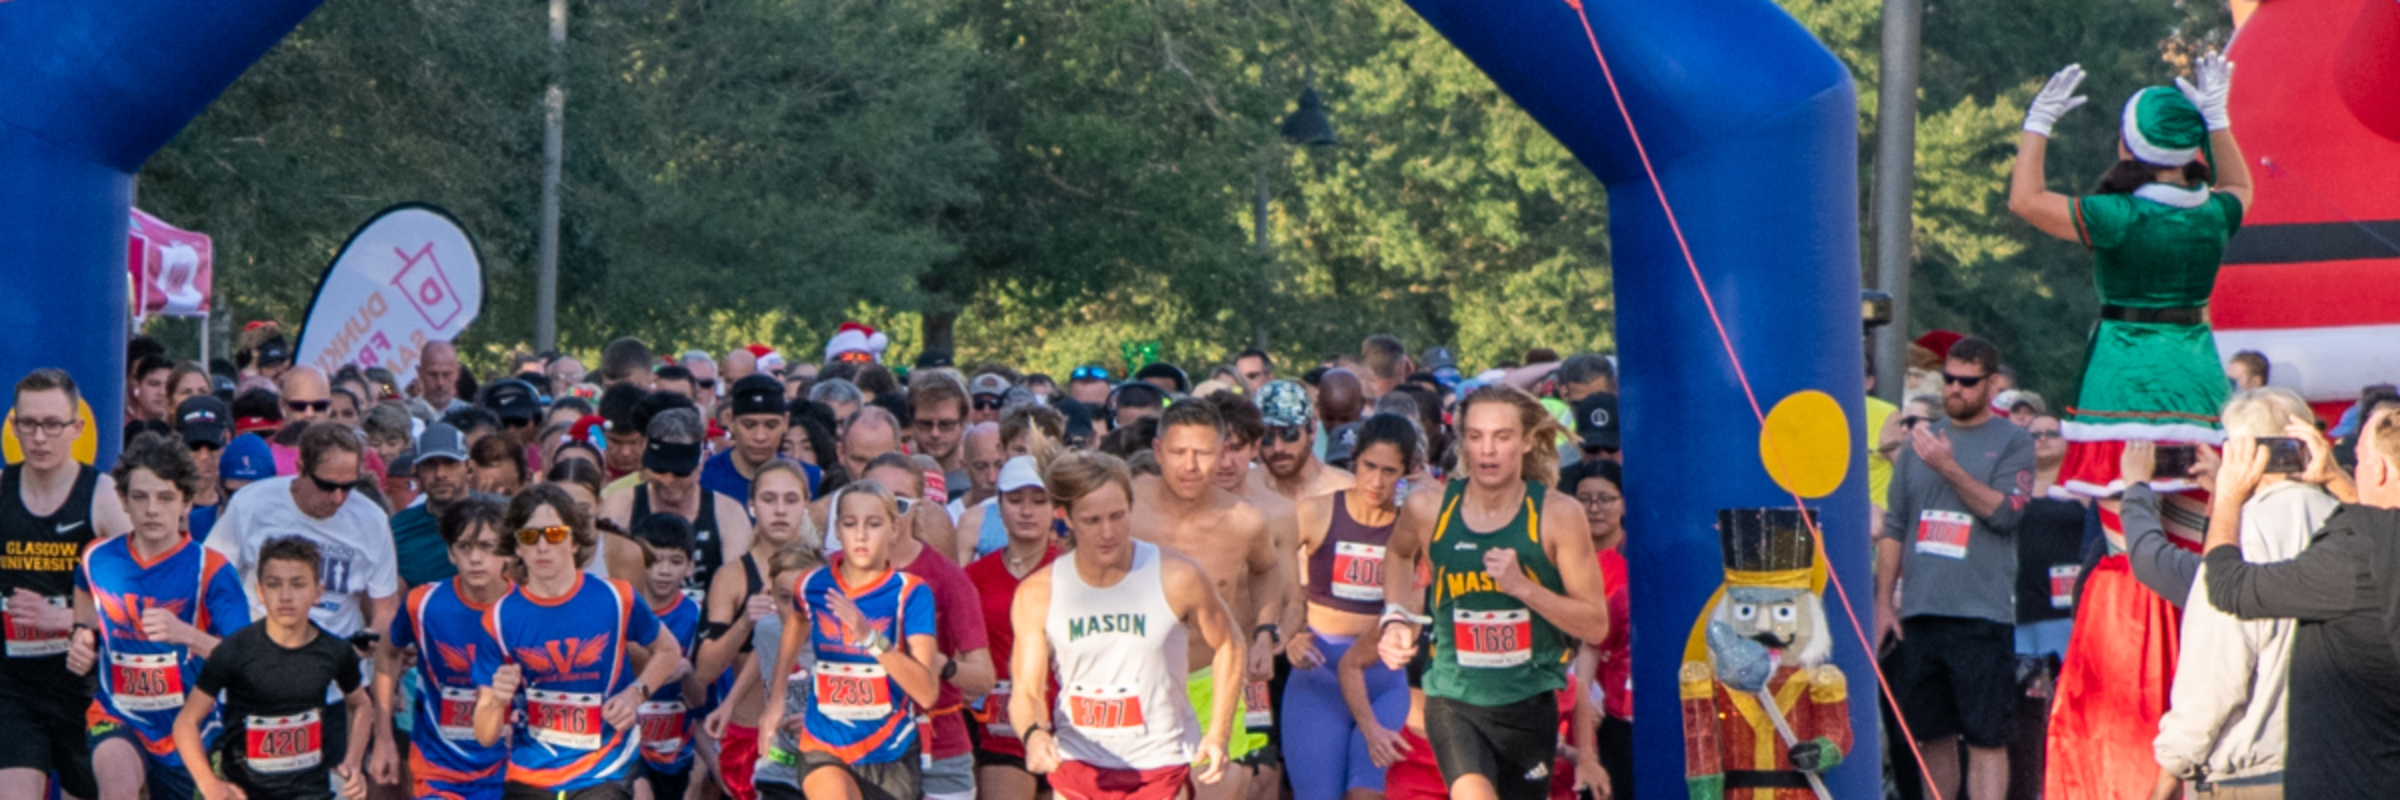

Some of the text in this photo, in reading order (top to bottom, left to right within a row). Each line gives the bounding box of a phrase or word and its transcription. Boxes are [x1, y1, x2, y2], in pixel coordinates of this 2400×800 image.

[6, 541, 78, 556] GLASGOW
[1068, 613, 1146, 642] MASON
[1471, 625, 1516, 653] 168
[122, 669, 168, 696] 346
[829, 676, 875, 705] 239
[539, 703, 586, 733] 316
[1082, 698, 1125, 726] 377
[260, 727, 308, 755] 420
